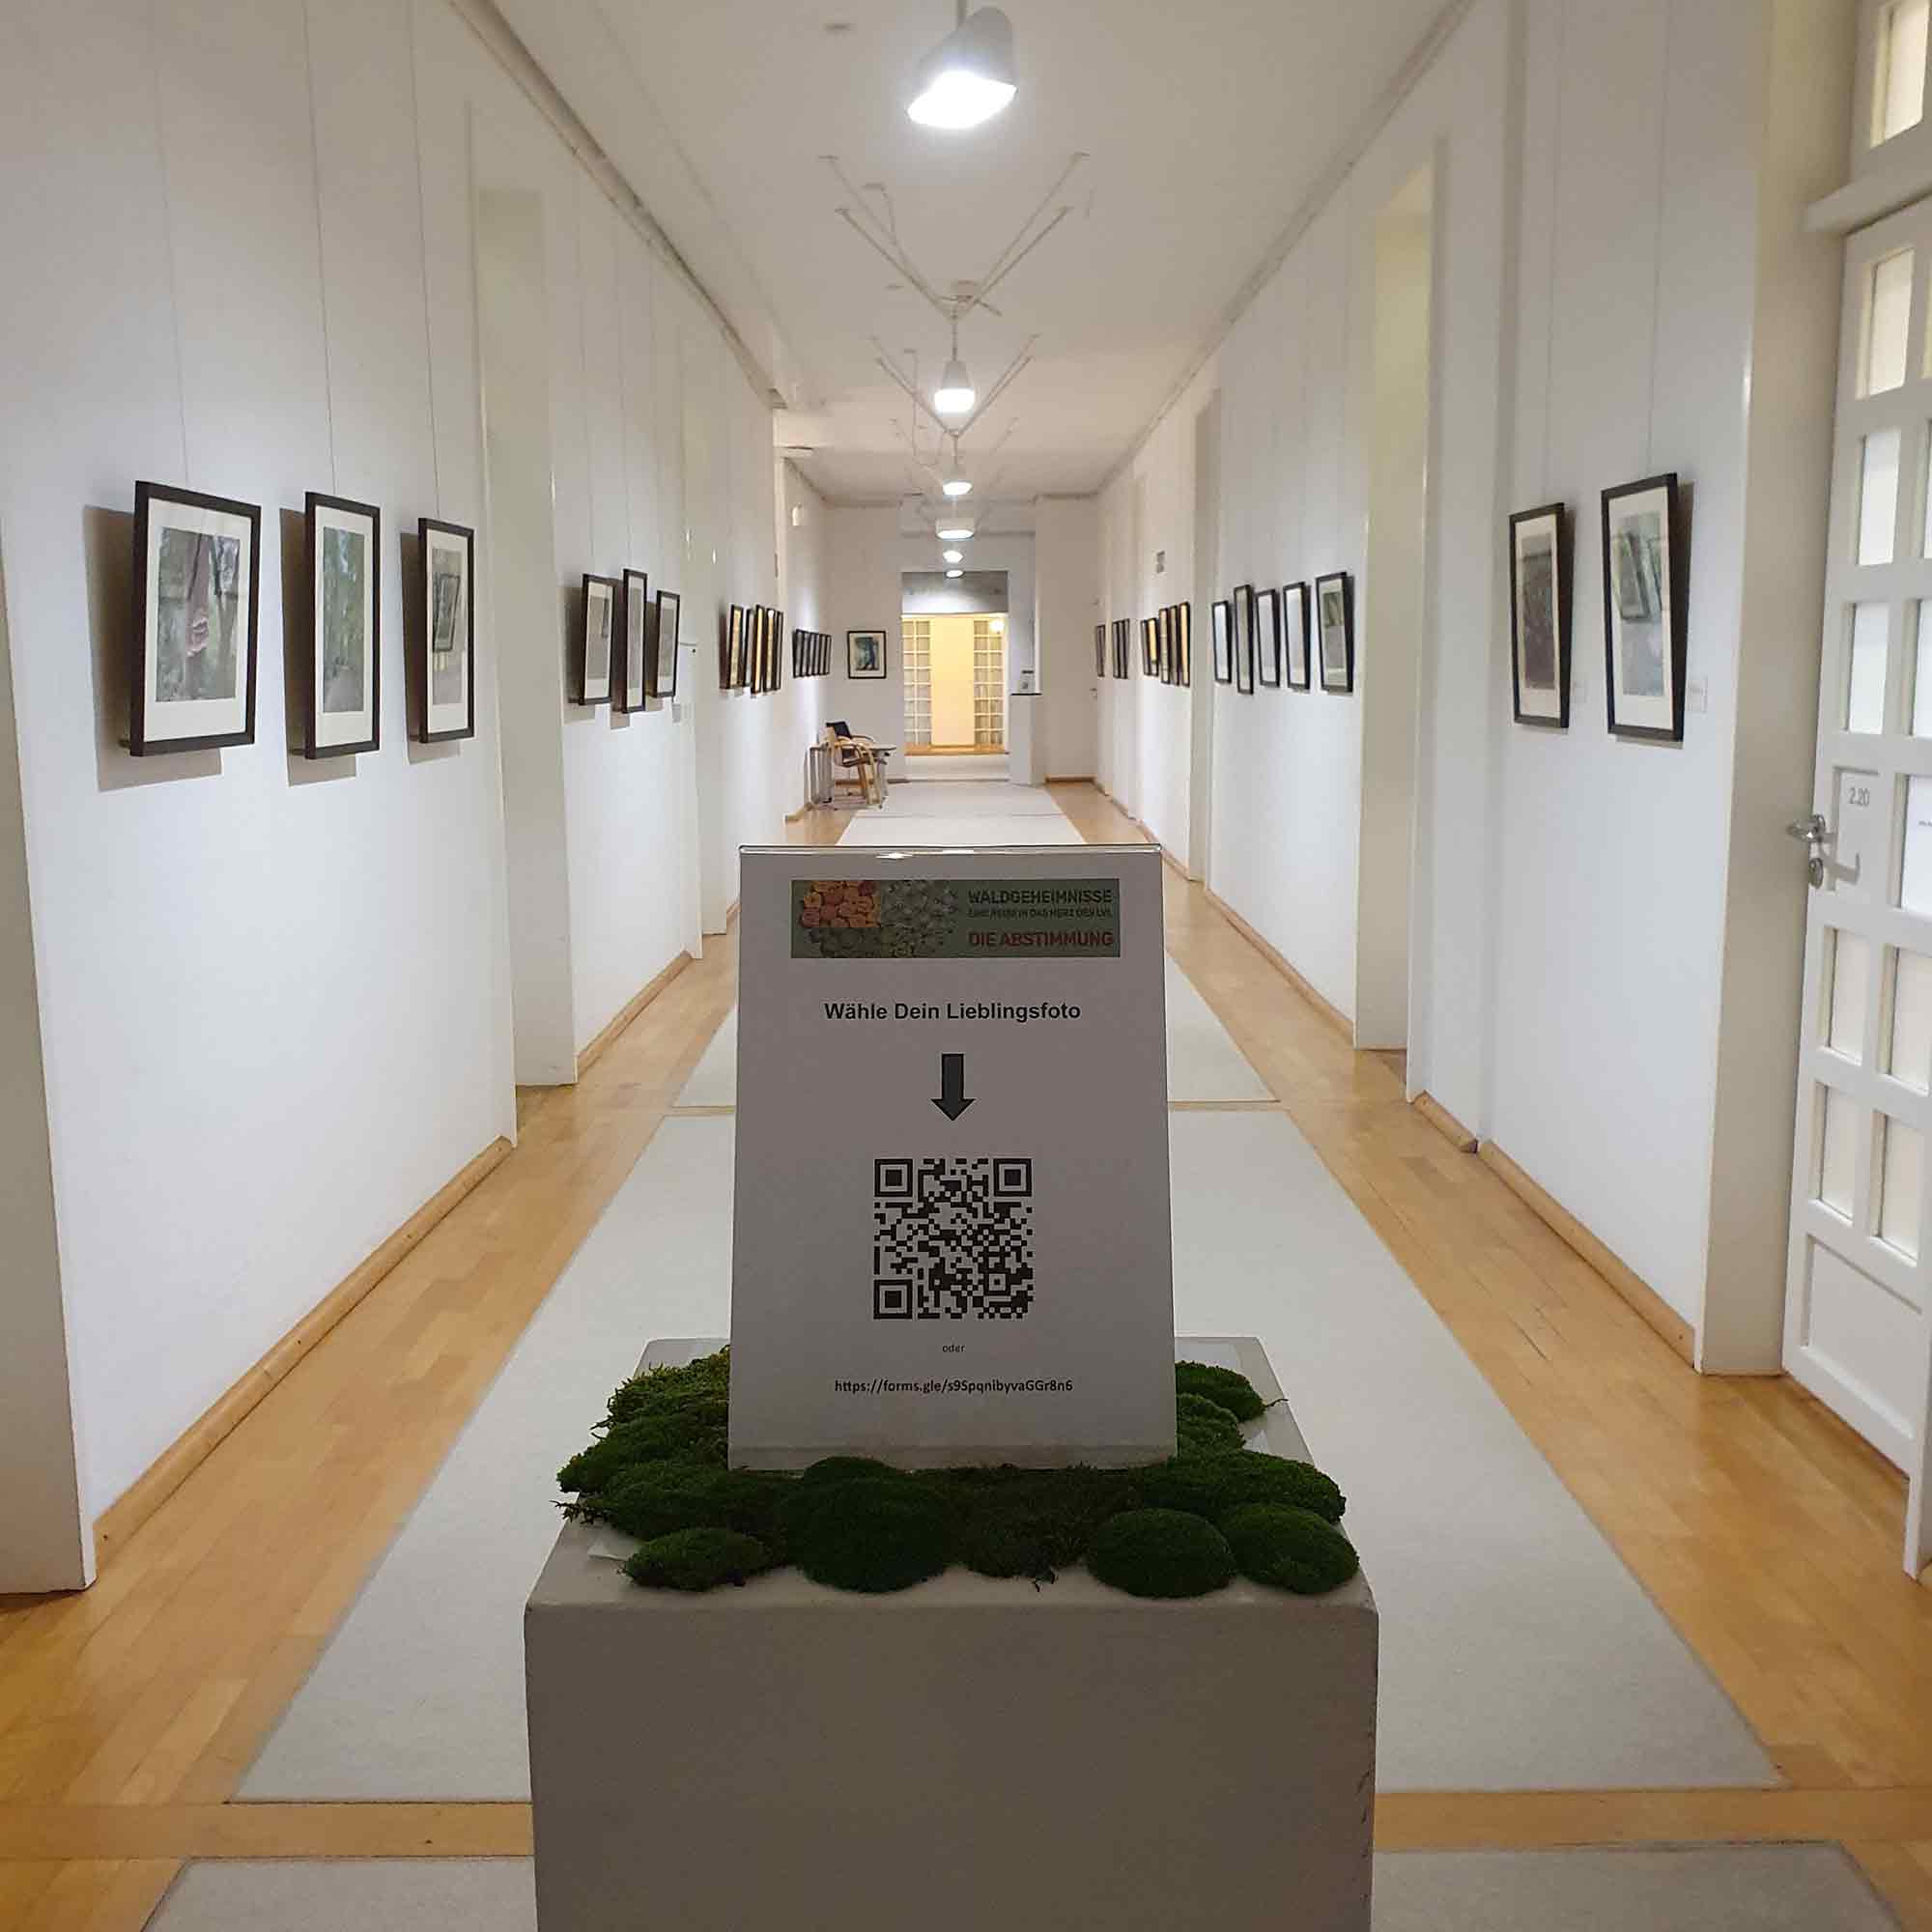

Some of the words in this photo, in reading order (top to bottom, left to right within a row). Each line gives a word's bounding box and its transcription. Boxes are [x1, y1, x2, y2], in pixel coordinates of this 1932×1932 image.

[968, 889, 1112, 903] WALDGEHEIMNISSE
[968, 931, 997, 947] DIE
[1001, 931, 1114, 947] ABSTIMMUNG
[824, 1003, 888, 1020] Wähle
[895, 1003, 940, 1020] Dein
[947, 1003, 1081, 1023] Lieblingsfoto
[942, 1343, 965, 1352] oder
[835, 1378, 1073, 1394] https://forms.gle/s9SpqnibyvaGGr8n6
